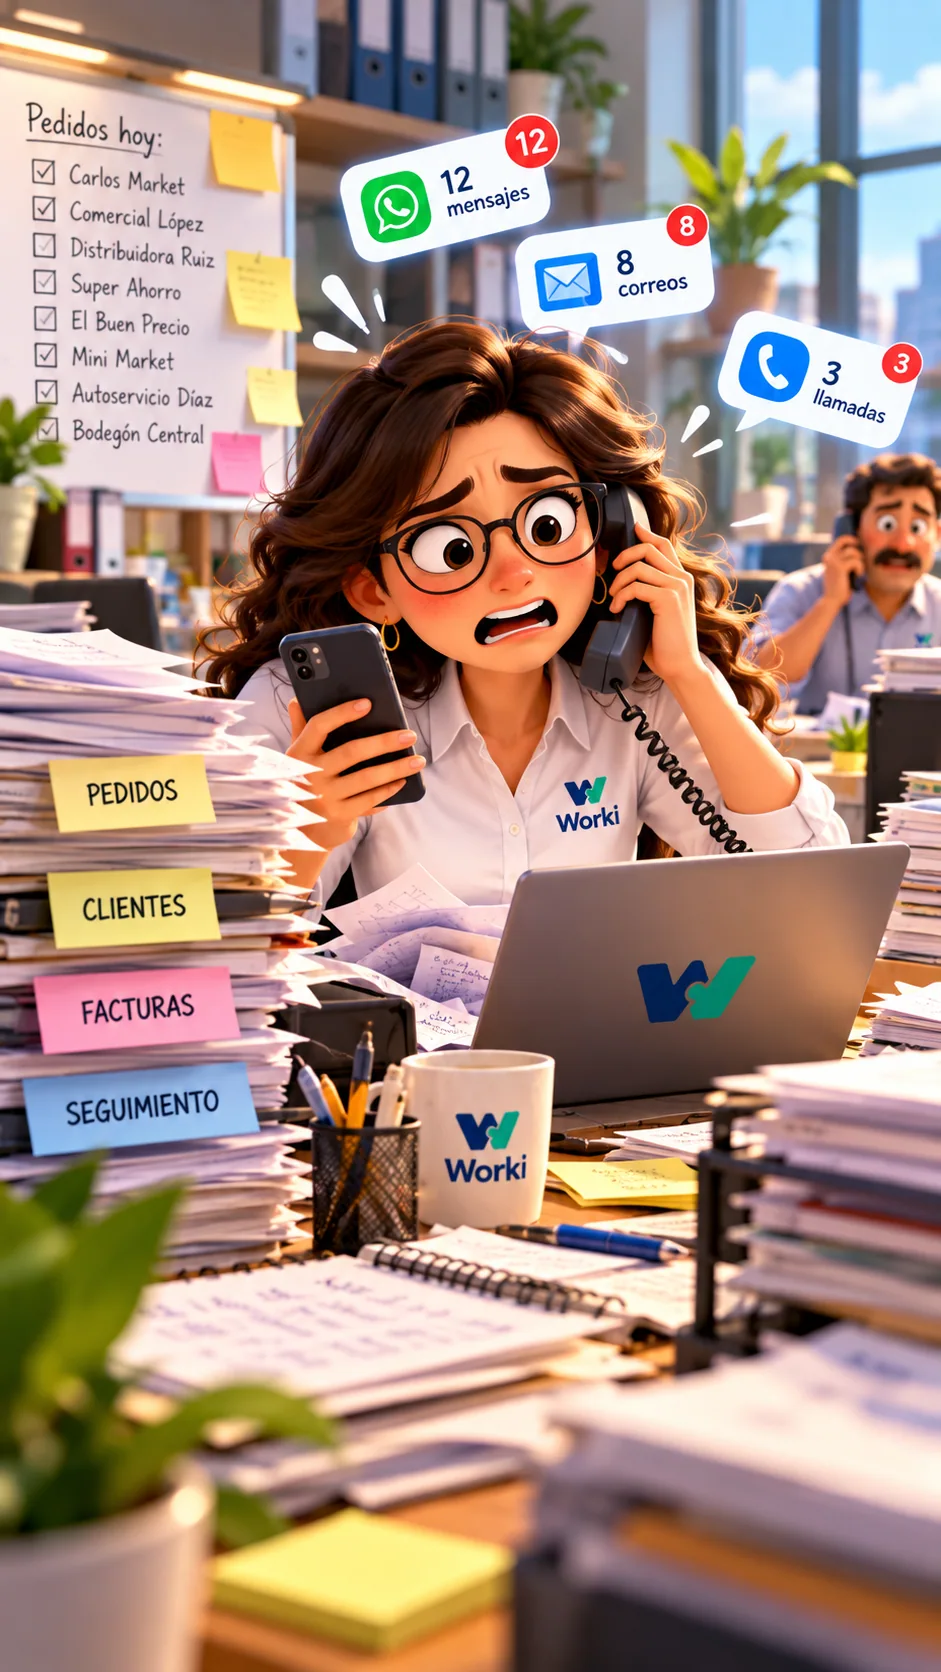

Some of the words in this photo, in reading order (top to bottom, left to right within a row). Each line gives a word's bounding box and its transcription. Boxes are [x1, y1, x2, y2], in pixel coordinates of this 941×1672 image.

[25, 102, 109, 141] Pedidos
[119, 116, 163, 158] hoy:
[69, 164, 120, 189] Carlos
[128, 172, 185, 196] Market
[70, 201, 150, 228] Comercial
[158, 210, 204, 237] López
[71, 237, 175, 265] Distribuidora
[181, 246, 215, 268] Ruiz
[71, 273, 119, 302] Super
[126, 277, 182, 300] Ahorro
[72, 310, 87, 331] El
[96, 311, 135, 333] Buen
[142, 313, 190, 336] Precio
[72, 346, 107, 368] Mini
[115, 349, 174, 371] Market
[72, 382, 170, 407] Autoservicio
[178, 387, 214, 408] Díaz
[73, 419, 140, 449] Bodegón
[147, 423, 204, 444] Central
[87, 779, 178, 806] PEDIDOS
[555, 804, 620, 833] Worki
[82, 894, 187, 922] CLIENTES
[81, 993, 195, 1024] FACTURAS
[66, 1089, 219, 1126] SEGUIMIENTO
[444, 1154, 527, 1183] Worki
